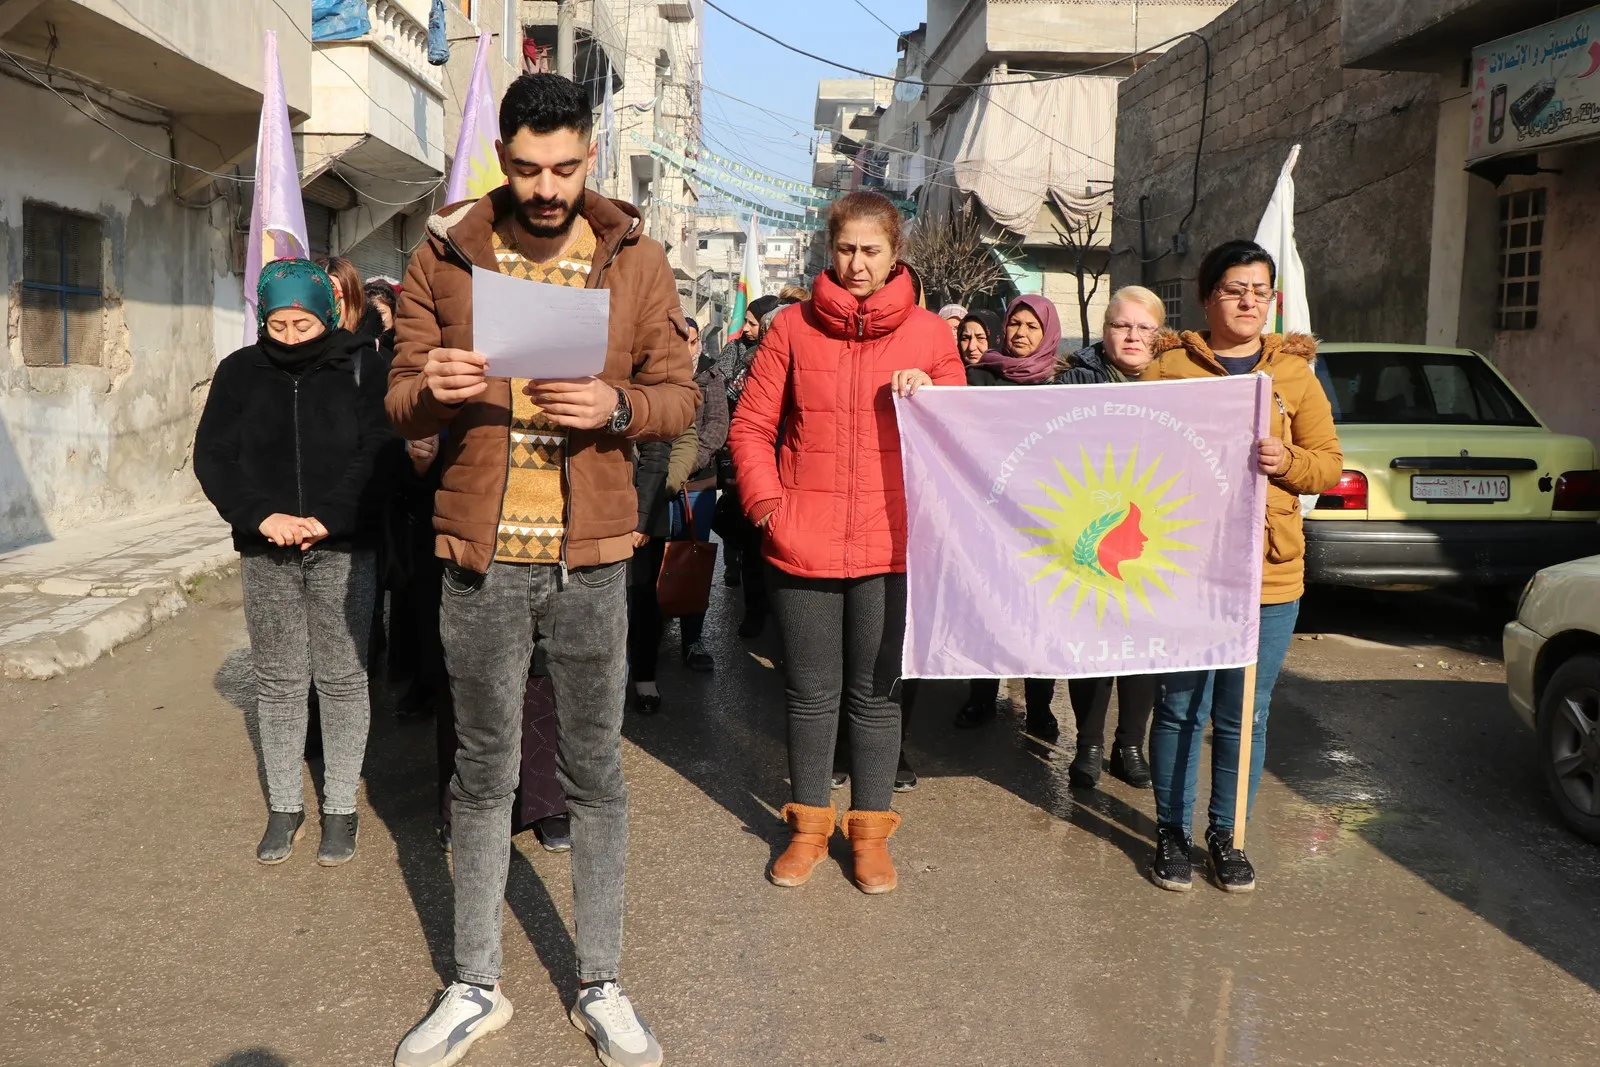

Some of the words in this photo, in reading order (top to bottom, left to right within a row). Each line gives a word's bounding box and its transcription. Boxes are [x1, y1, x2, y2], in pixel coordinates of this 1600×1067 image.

[1046, 405, 1097, 435] JINÊN
[1103, 401, 1183, 432] ÊZDIYÊN
[1182, 427, 1230, 496] ROJAVA
